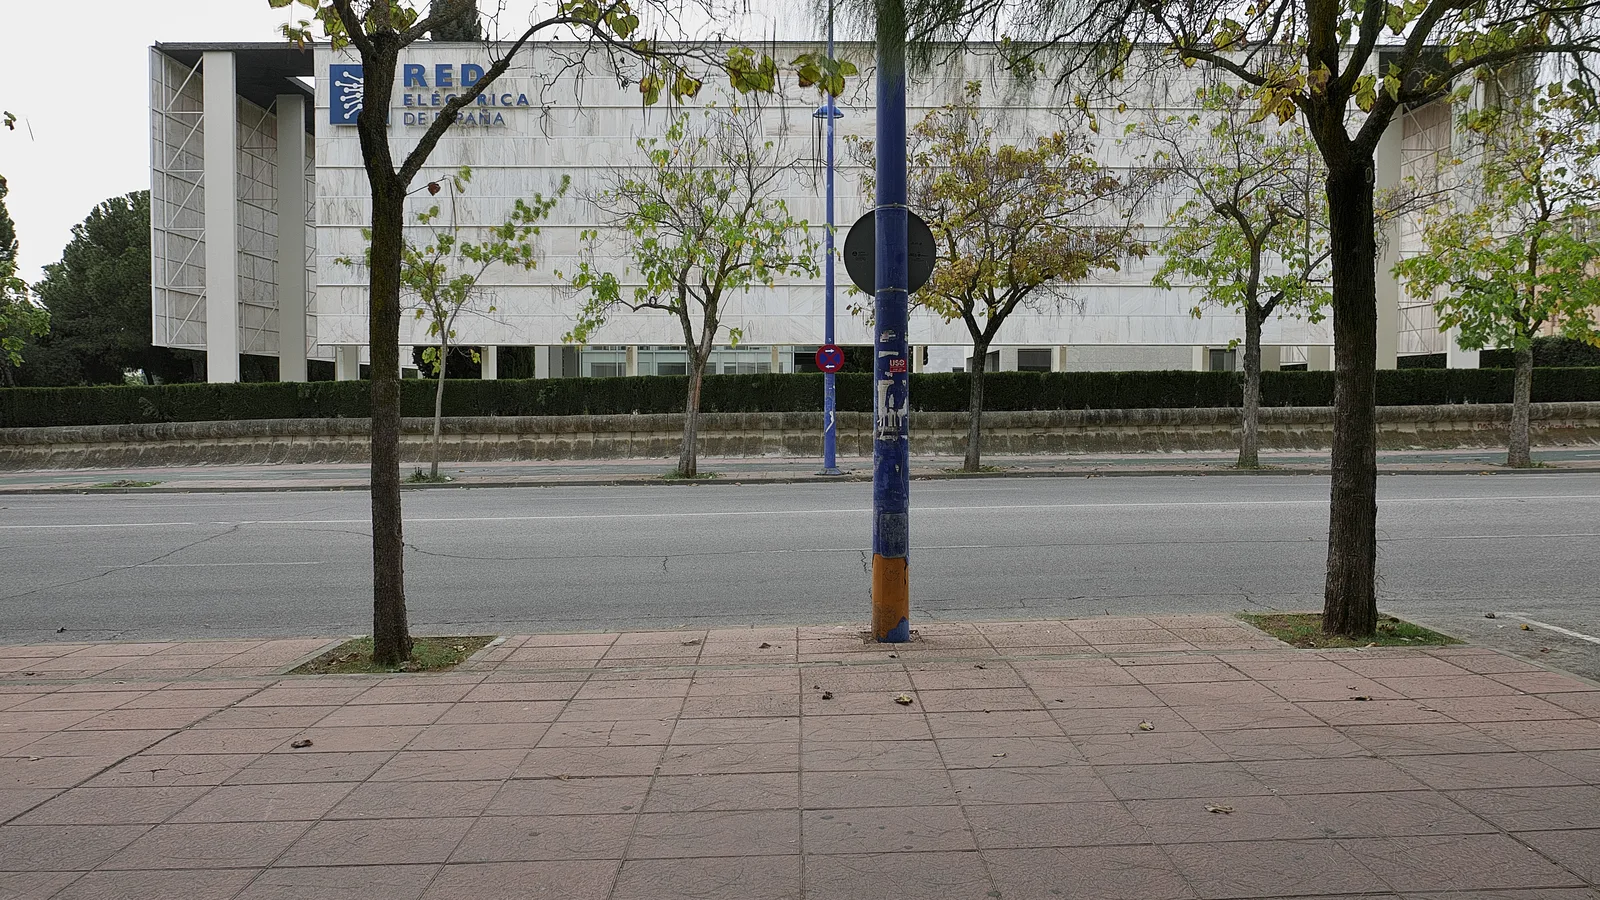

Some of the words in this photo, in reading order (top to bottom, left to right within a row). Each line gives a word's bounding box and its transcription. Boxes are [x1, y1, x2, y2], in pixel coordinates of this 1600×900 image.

[403, 63, 485, 87] RED
[403, 91, 529, 106] ELÉCRICA
[403, 112, 427, 126] DE
[434, 109, 505, 125] PAÑA
